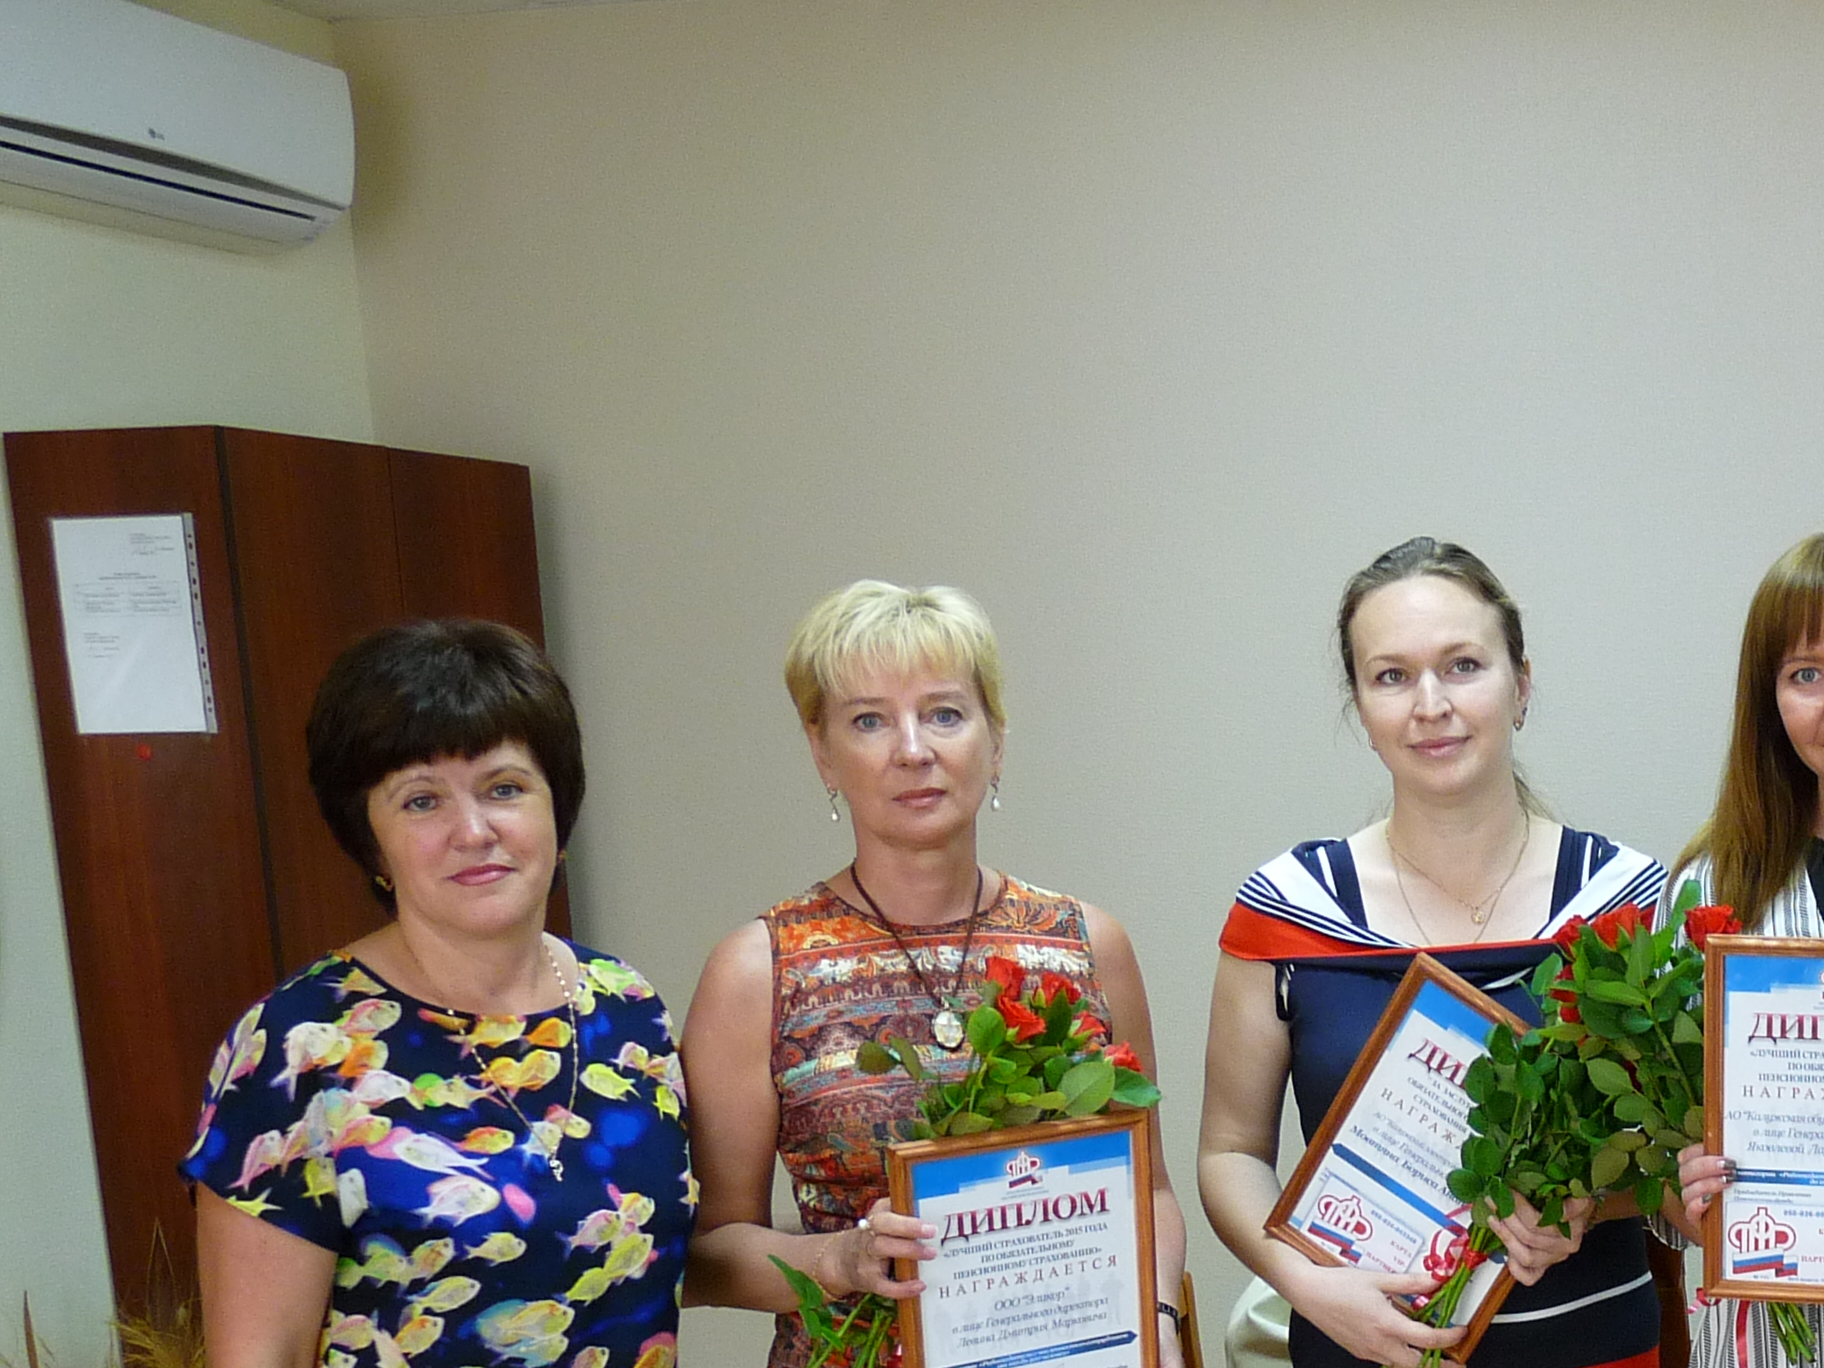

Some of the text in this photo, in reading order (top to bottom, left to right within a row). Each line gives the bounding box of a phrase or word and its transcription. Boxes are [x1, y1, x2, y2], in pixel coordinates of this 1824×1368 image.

[1380, 1088, 1460, 1149] НАГРАЖ
[941, 1187, 1110, 1246] ДИПЛОМ
[994, 1231, 1064, 1252] СТРАХОВАТЕЛЬ
[1065, 1227, 1083, 1237] 2015
[1084, 1222, 1108, 1234] ГОДА
[995, 1239, 1075, 1261] ОБЯЗАТЕЛЬНОМУ
[1390, 1240, 1412, 1258] КАРТА
[939, 1255, 1117, 1299] НАГРАЖДАЕТСЯ
[953, 1260, 1028, 1280] ПЕНСИОННОМУ
[994, 1297, 1020, 1311] ООО
